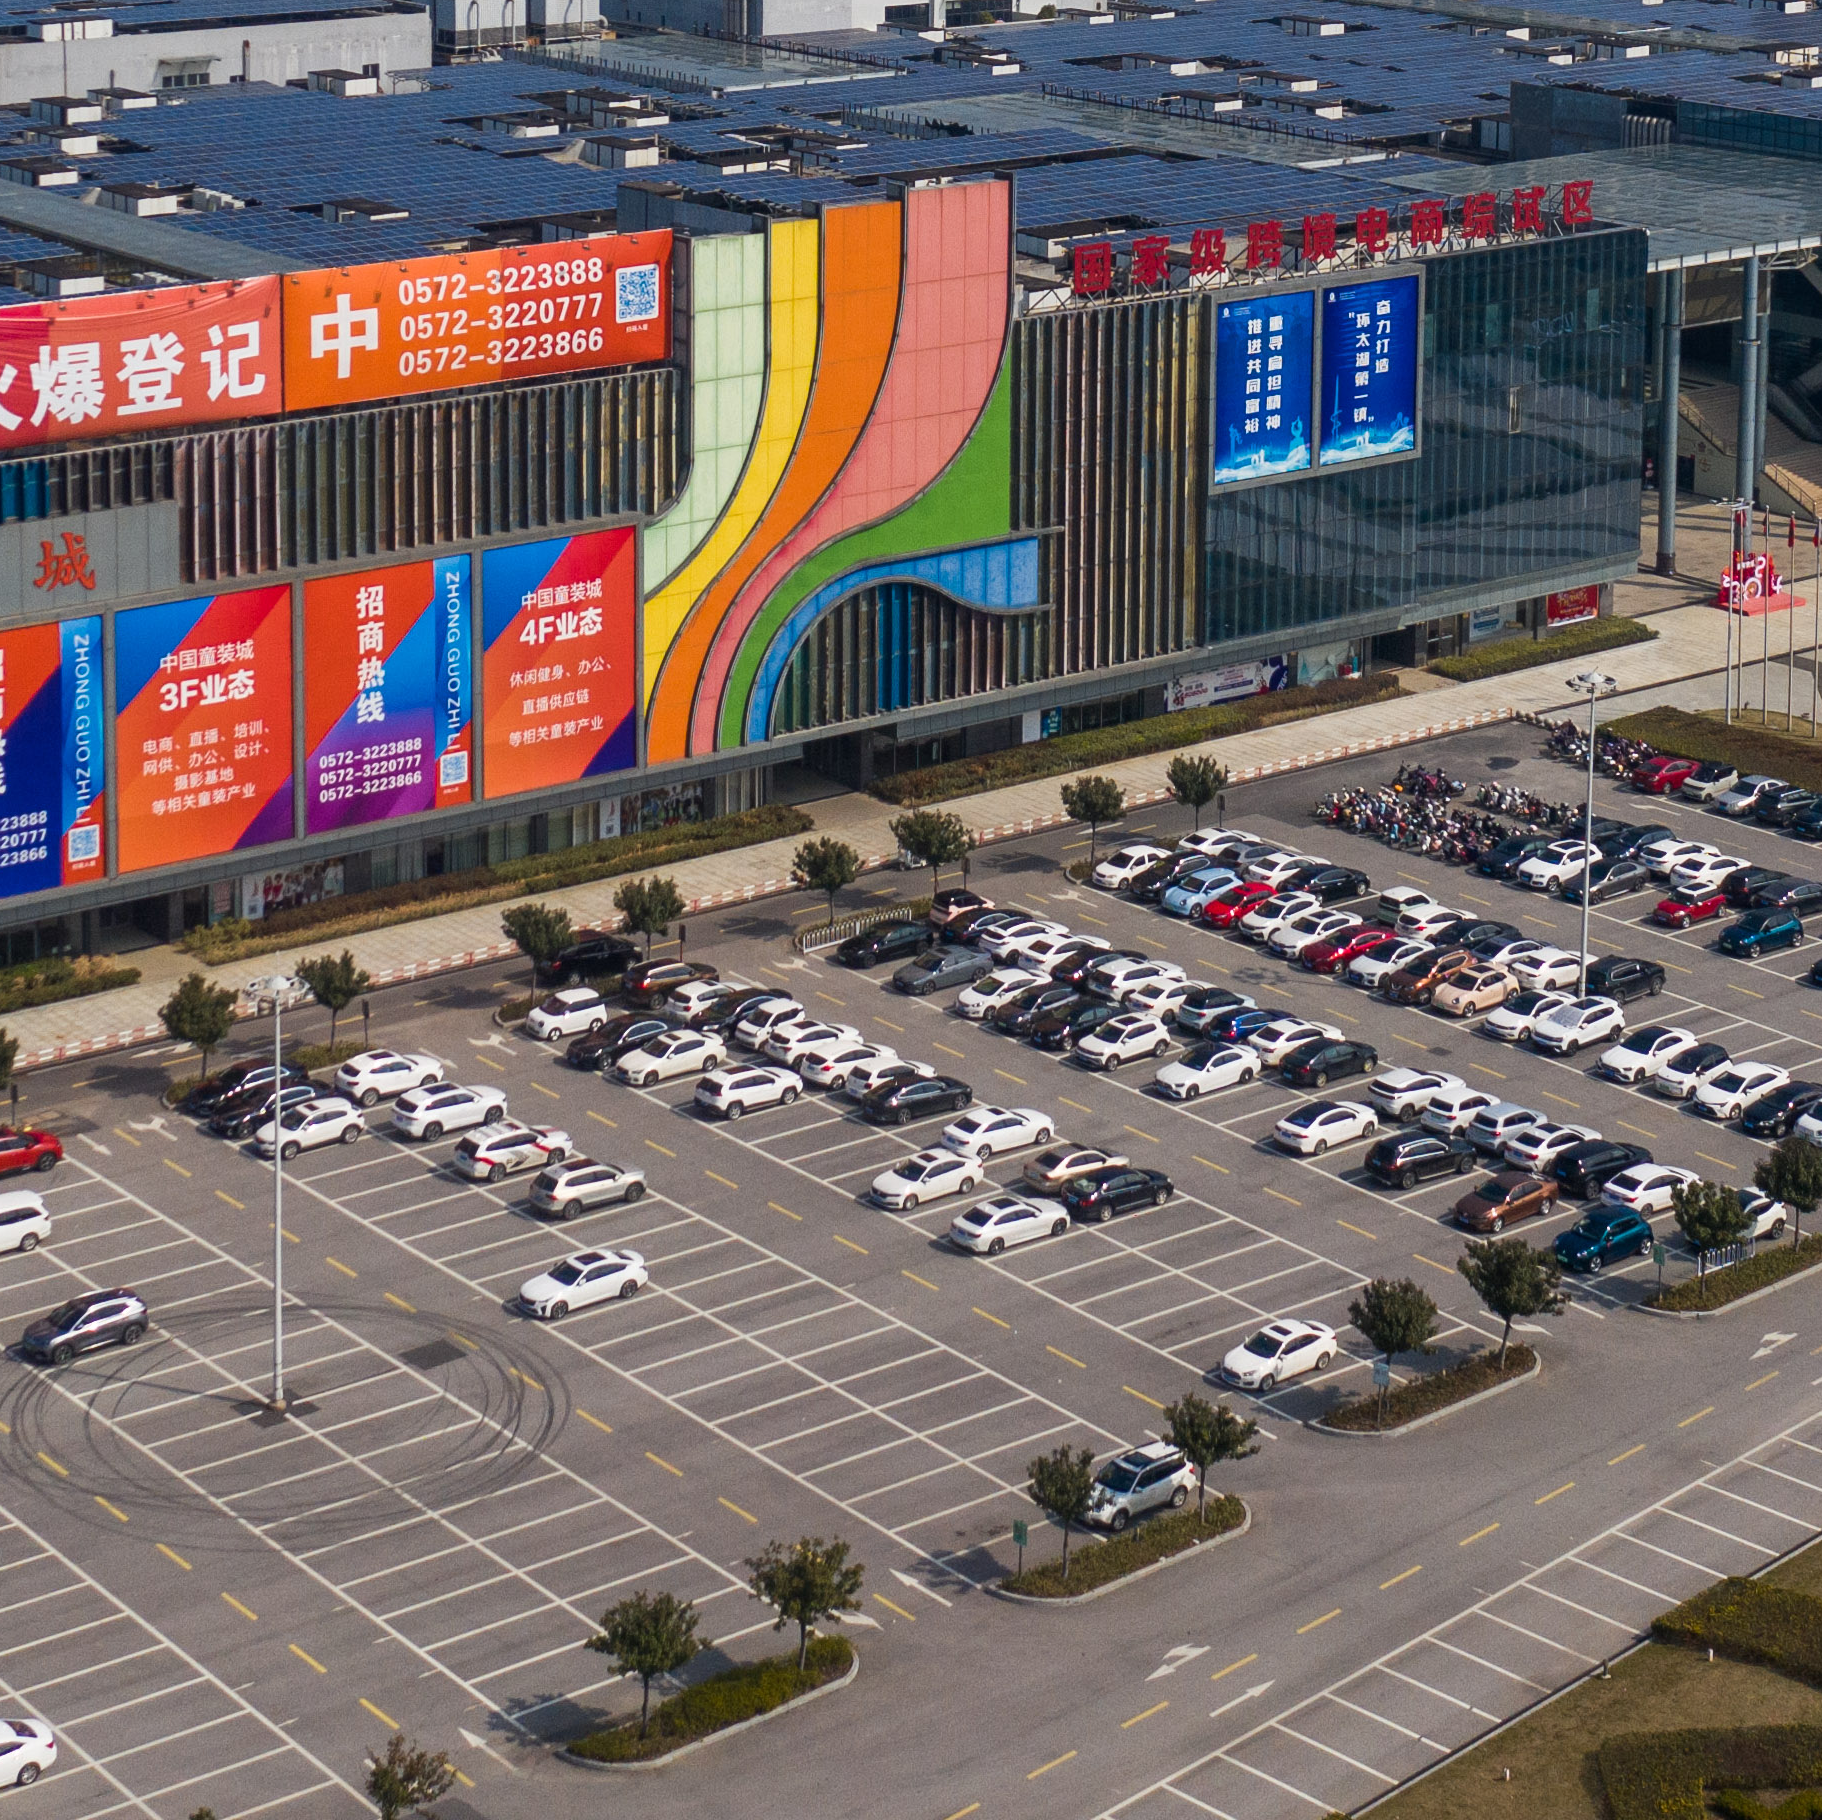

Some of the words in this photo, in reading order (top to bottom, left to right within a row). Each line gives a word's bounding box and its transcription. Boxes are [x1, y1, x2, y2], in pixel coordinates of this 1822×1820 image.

[1074, 180, 1594, 294] 国家级跨境电商综试区
[398, 256, 603, 306] 0572-3223888
[399, 292, 603, 341] 0572-3220777
[310, 293, 378, 380] 中
[399, 327, 604, 377] 0572-3223866
[1375, 299, 1391, 374] 奋力打造
[1244, 318, 1262, 434] 推进共同富裕
[446, 571, 460, 644] ZHONG
[521, 577, 603, 611] 中国童装城
[520, 606, 603, 646] 4F业态
[74, 634, 90, 711] ZHONG
[159, 638, 254, 675] 中国童装城
[356, 585, 385, 724] 招商热线
[447, 648, 461, 692] GUO
[509, 655, 612, 689] 休闲健身、办公、
[159, 668, 255, 712] 3F业态
[522, 688, 590, 716] 直播供应链
[447, 697, 461, 729] ZHI
[509, 715, 604, 748] 等相关童装产业
[75, 715, 91, 763] GUO
[143, 719, 270, 755] 电商、直播、培训、
[319, 737, 422, 769] 0572-3223888
[447, 732, 461, 750] LI
[143, 740, 270, 777] 网供、办公、设计、
[319, 754, 422, 786] 0572-3220777
[76, 767, 91, 800] ZHI
[173, 766, 234, 792] 摄影基地
[319, 771, 422, 803] 0572-3223866
[76, 804, 91, 823] LI
[151, 782, 255, 816] 等相关童装产业
